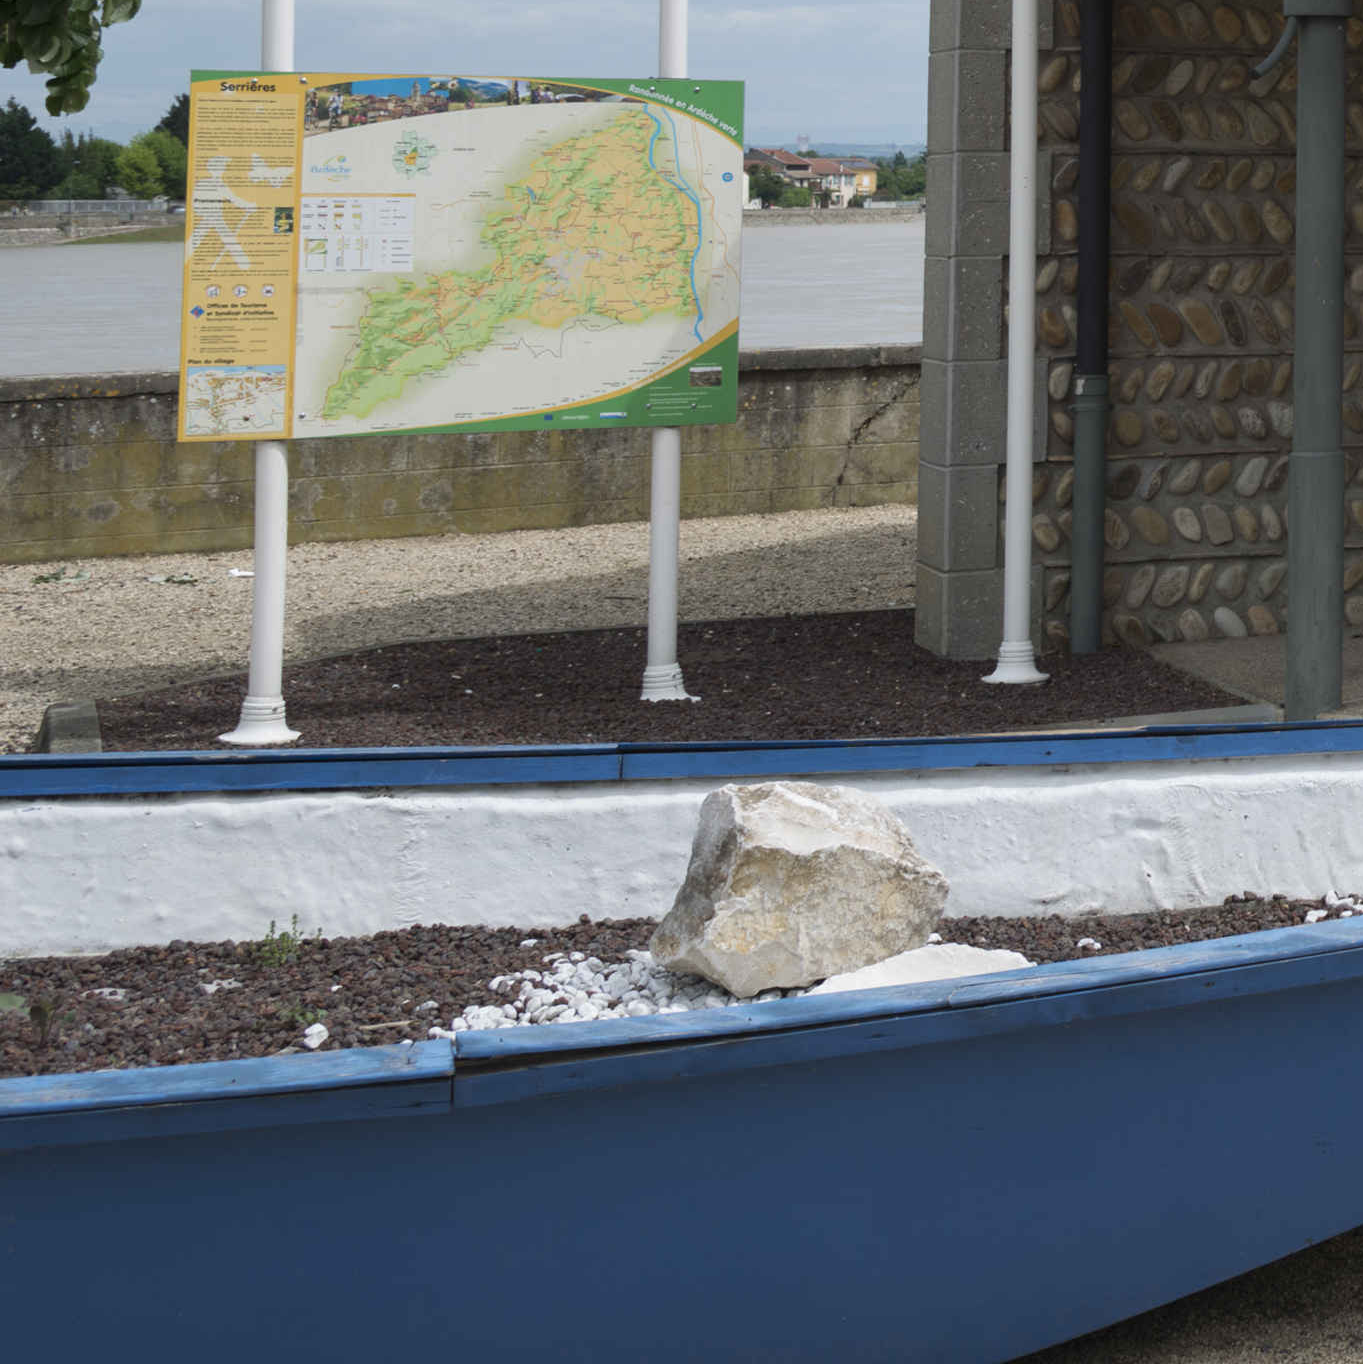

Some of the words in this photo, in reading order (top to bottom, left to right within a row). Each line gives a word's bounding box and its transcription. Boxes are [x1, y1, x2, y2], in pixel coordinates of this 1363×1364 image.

[675, 99, 687, 109] en
[687, 104, 719, 124] Ardèche
[719, 121, 738, 137] verte
[310, 165, 352, 173] Ardèche
